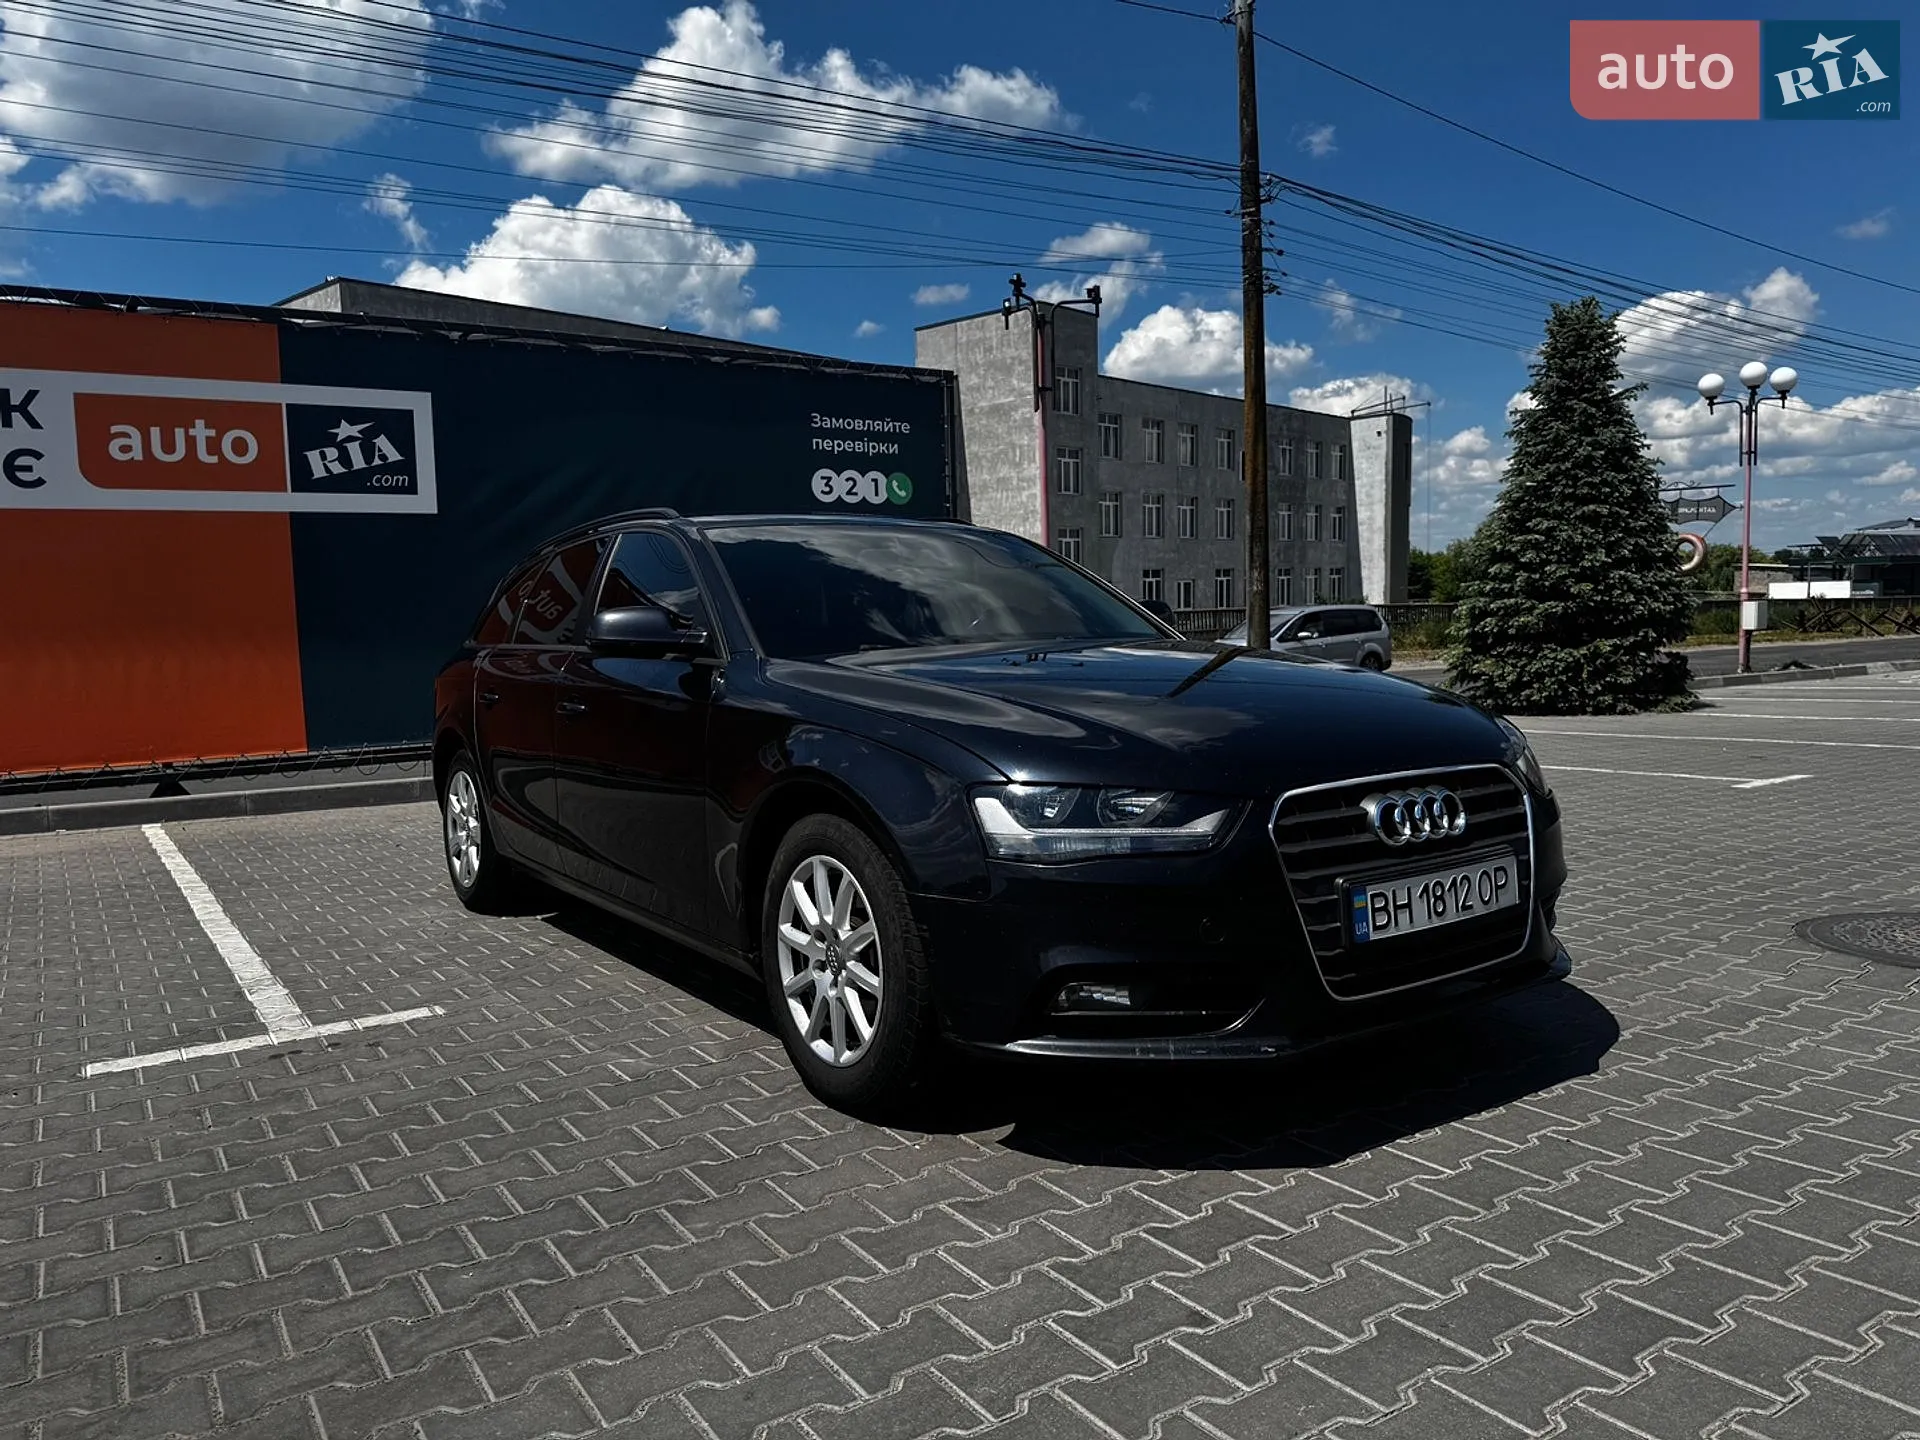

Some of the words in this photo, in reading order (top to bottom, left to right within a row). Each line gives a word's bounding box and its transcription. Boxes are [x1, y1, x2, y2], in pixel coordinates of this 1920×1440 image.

[810, 413, 911, 434] Замовляйте
[107, 419, 259, 465] auto
[302, 433, 406, 480] RIA
[366, 472, 409, 487] .com
[812, 437, 899, 456] перевірки
[819, 474, 881, 498] 321
[1369, 885, 1415, 932] BH
[1417, 872, 1474, 920] 1812
[1476, 865, 1508, 906] OP
[1354, 921, 1368, 935] UA
